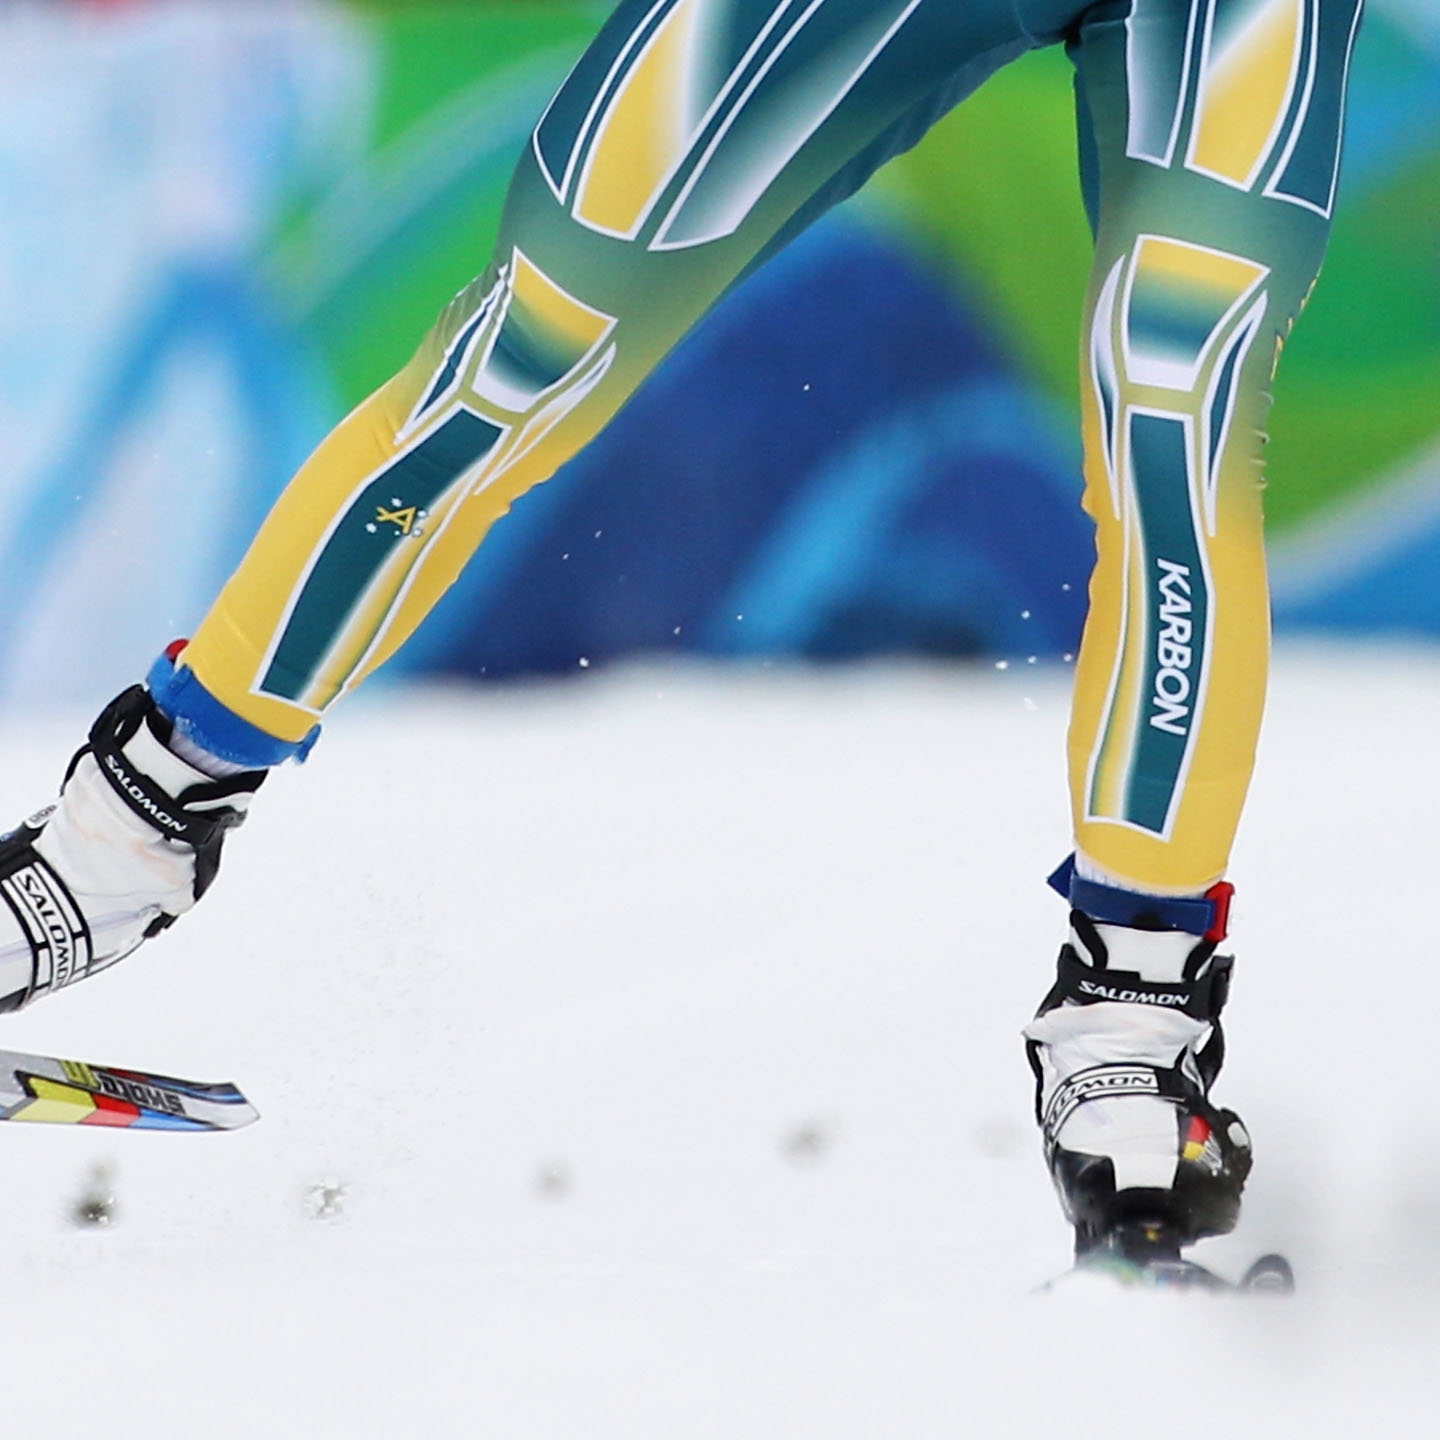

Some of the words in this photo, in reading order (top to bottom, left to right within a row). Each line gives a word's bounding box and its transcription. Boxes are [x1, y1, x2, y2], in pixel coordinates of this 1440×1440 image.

[1149, 557, 1194, 737] KARBON
[105, 753, 187, 834] SALOMON
[1078, 979, 1191, 1006] SALOMON
